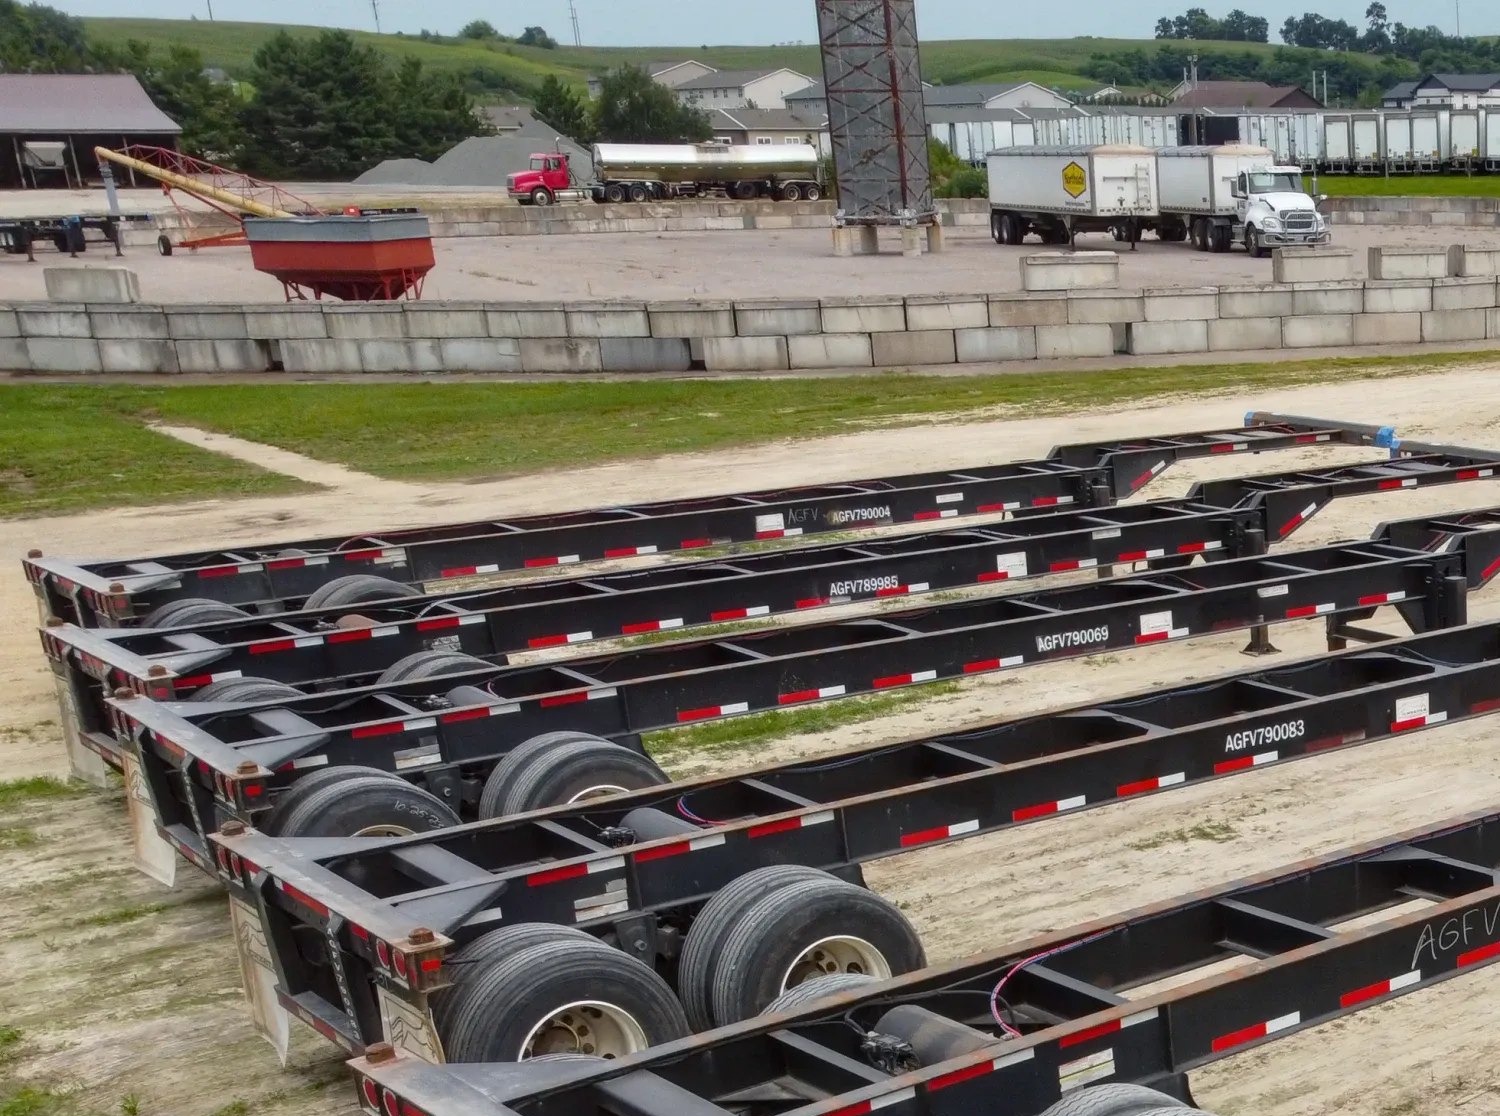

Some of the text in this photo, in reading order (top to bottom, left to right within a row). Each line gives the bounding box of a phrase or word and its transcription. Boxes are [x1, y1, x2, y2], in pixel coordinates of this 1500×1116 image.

[788, 507, 818, 525] AGFV
[832, 505, 891, 523] AGFV790004
[829, 575, 898, 596] AGFV789985
[1036, 626, 1109, 652] AGFV790069
[1225, 720, 1305, 752] AGFV790083
